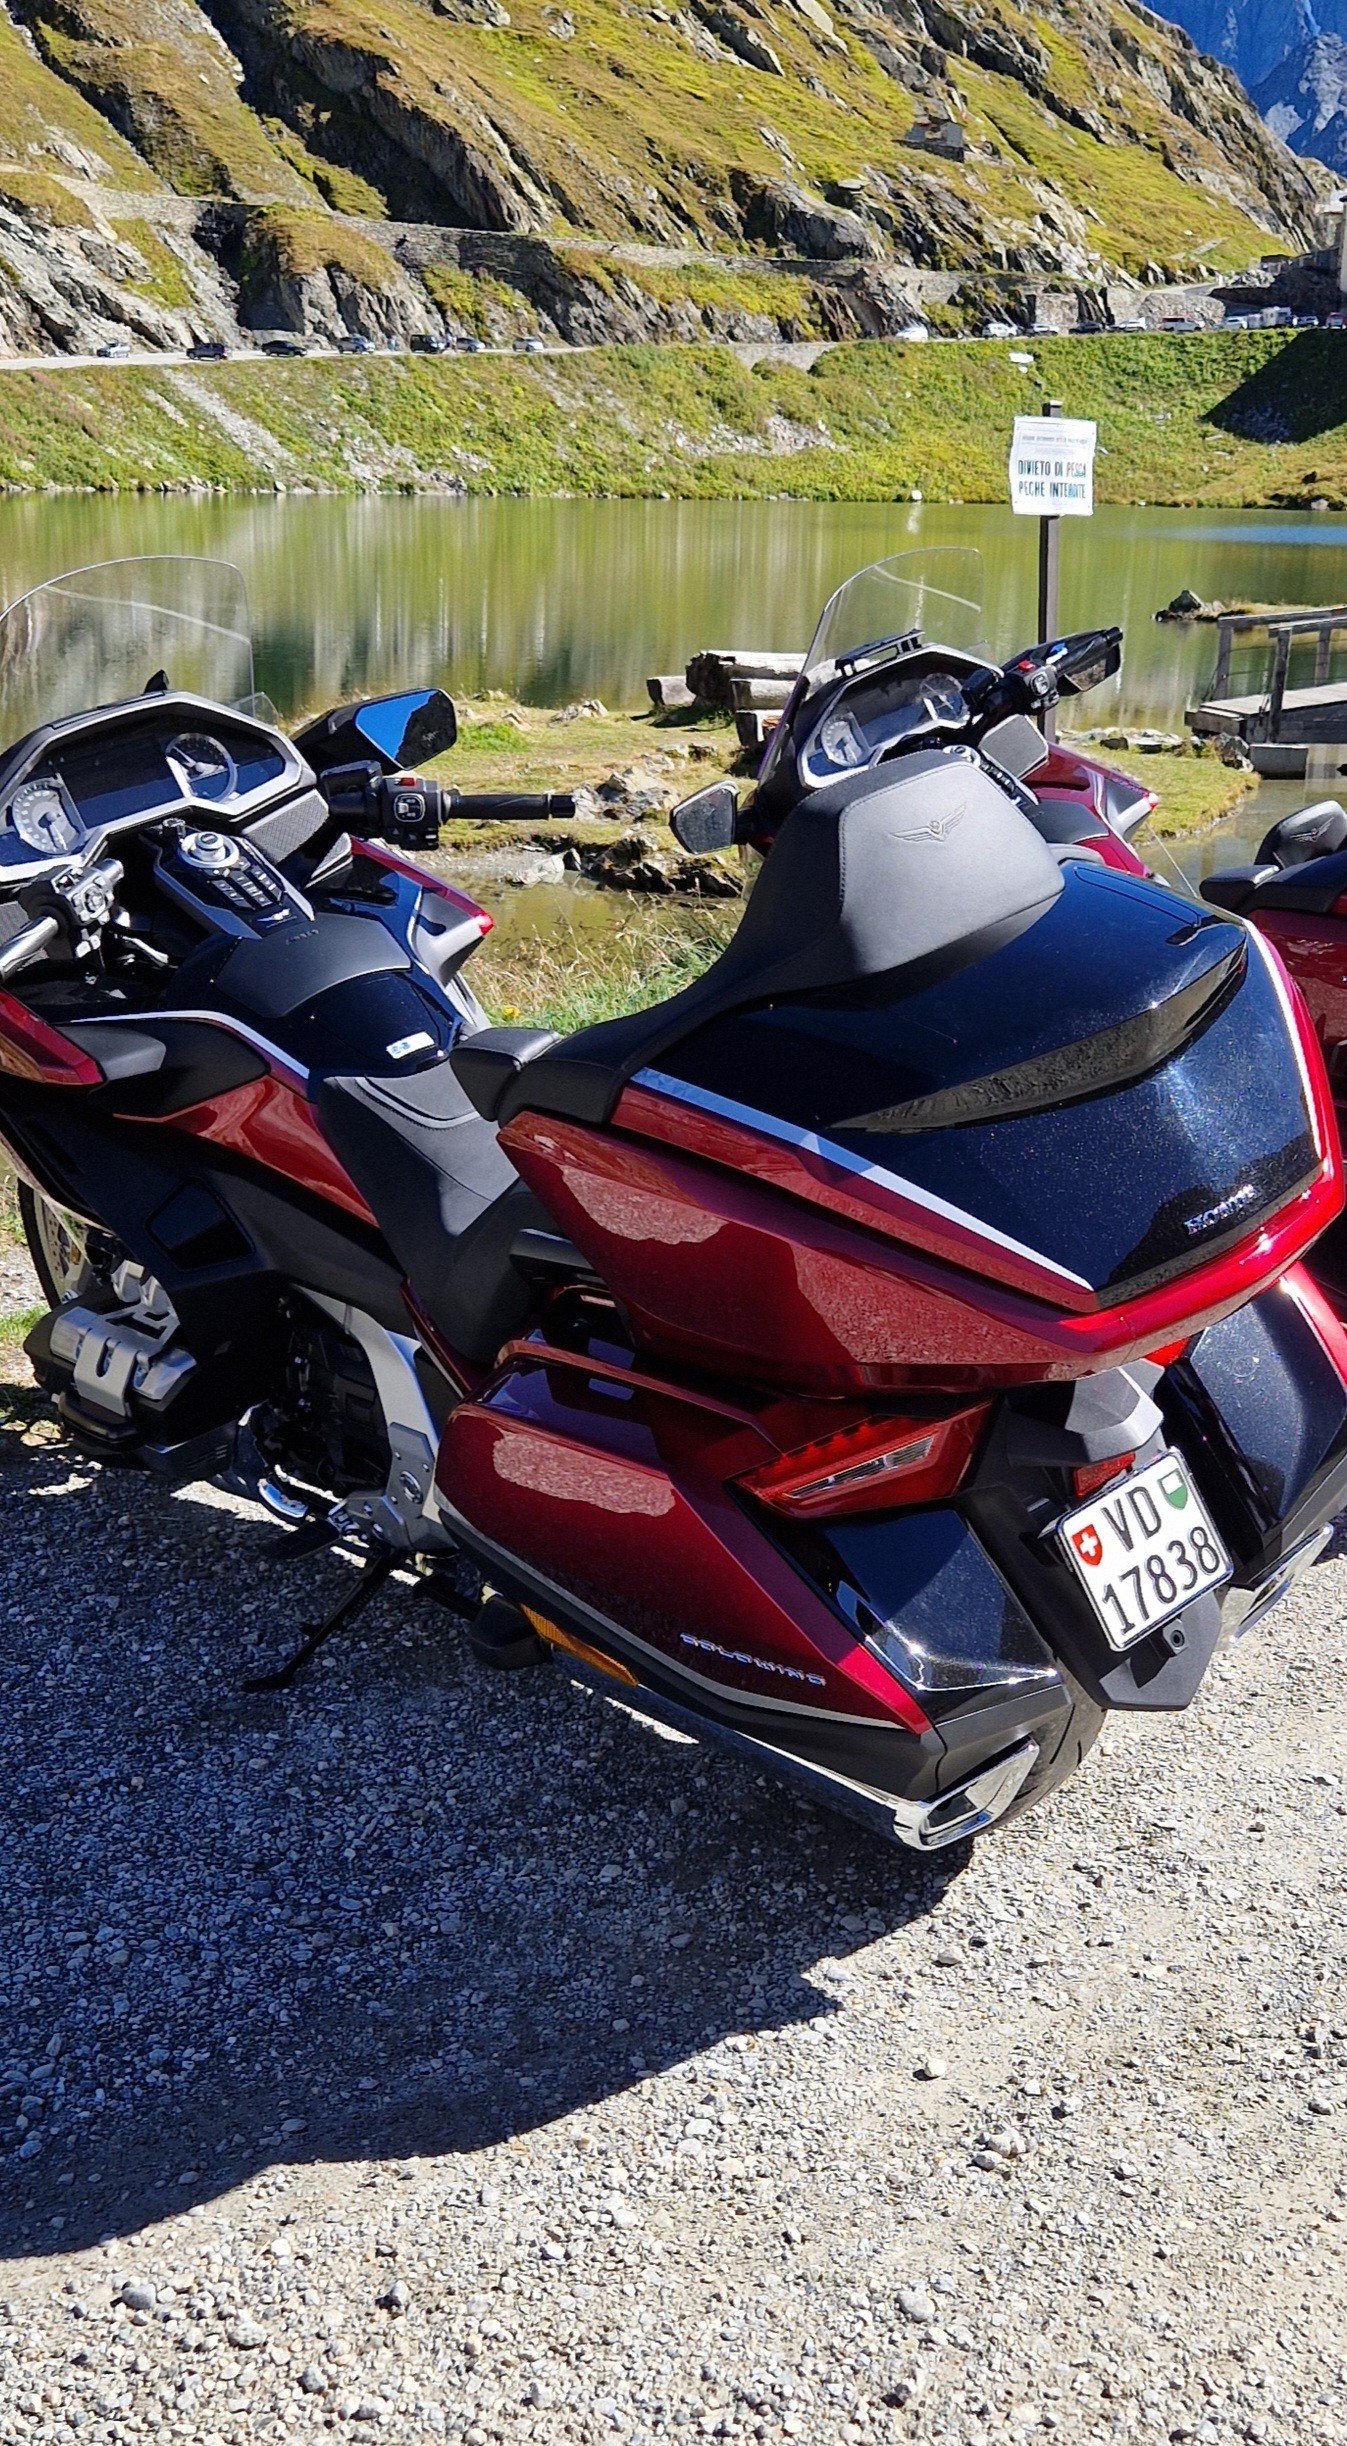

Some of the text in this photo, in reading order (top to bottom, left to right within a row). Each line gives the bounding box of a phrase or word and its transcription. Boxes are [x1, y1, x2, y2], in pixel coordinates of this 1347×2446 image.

[1018, 460, 1051, 476] DIVIETO
[1054, 461, 1063, 477] DI
[1019, 481, 1045, 496] PECHE
[1184, 1184, 1258, 1235] HONDA
[1101, 1486, 1162, 1552] VD
[1102, 1526, 1220, 1635] 17838
